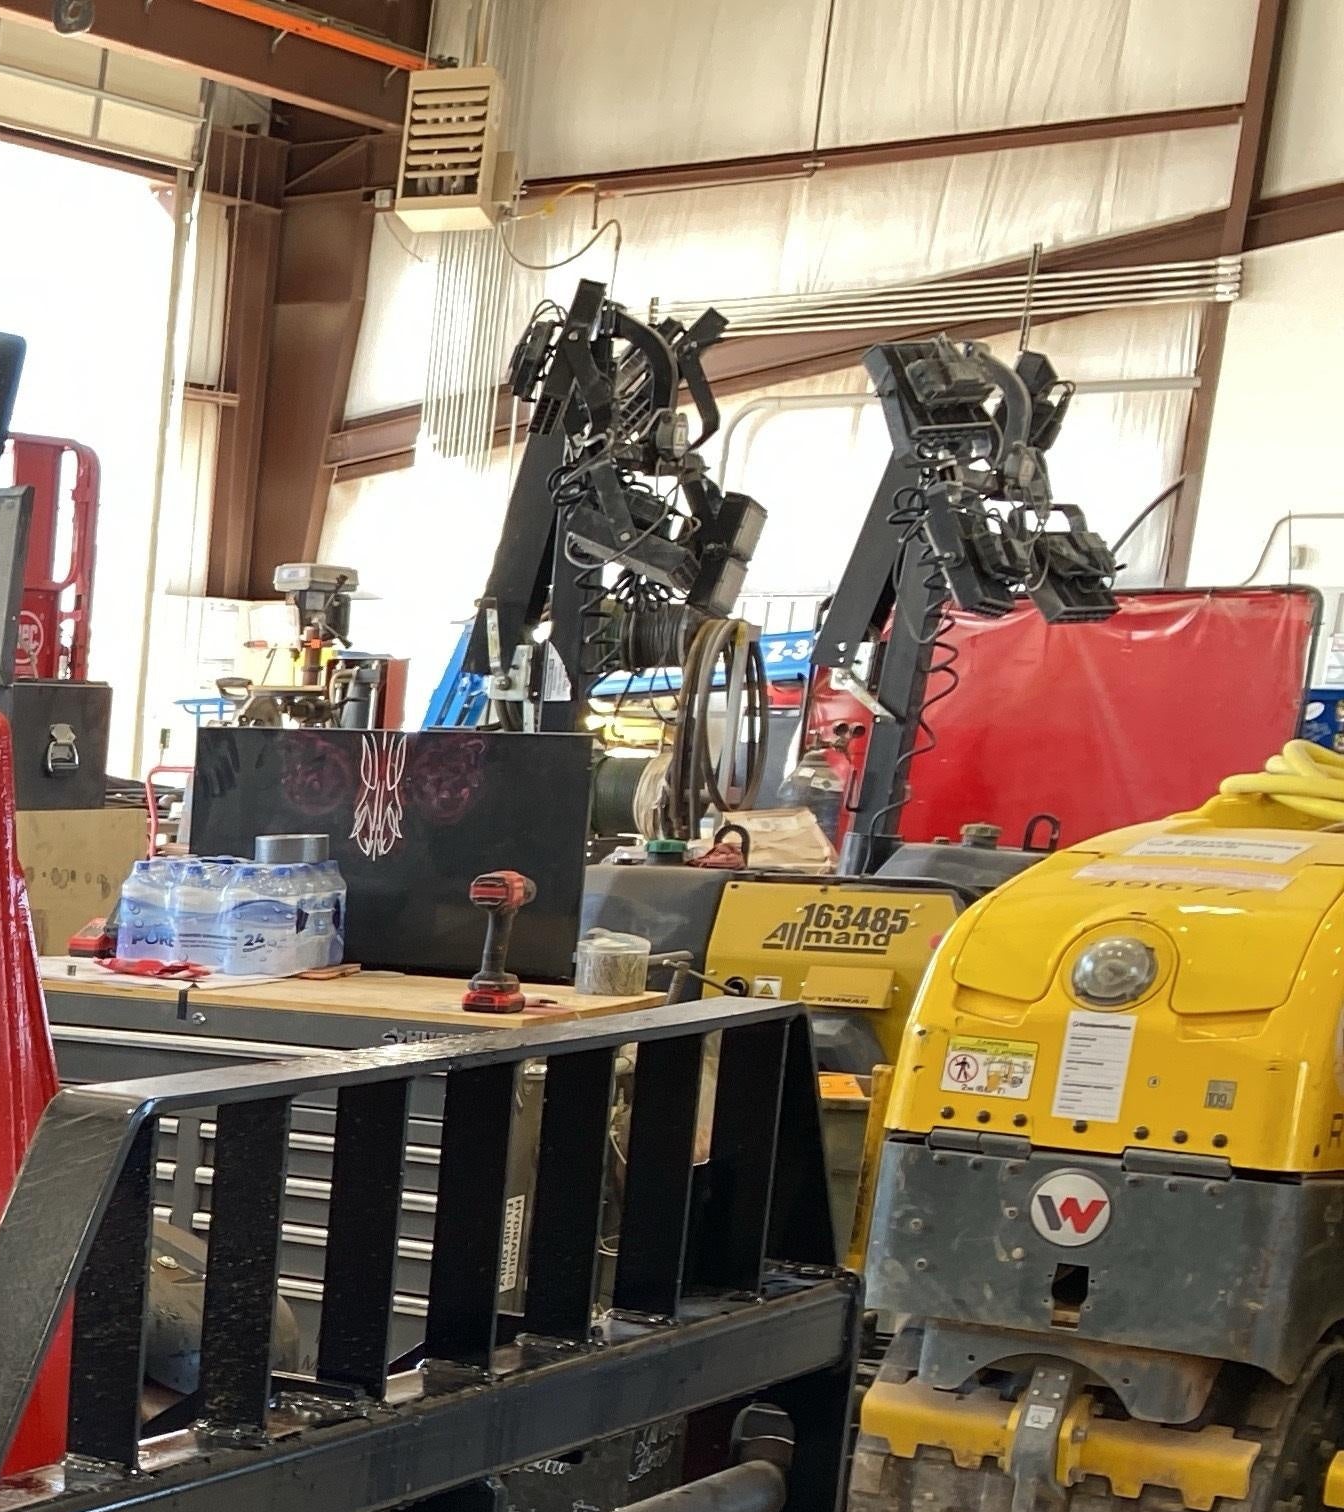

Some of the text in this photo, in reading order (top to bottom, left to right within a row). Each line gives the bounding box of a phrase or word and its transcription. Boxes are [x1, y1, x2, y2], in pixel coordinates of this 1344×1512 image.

[766, 639, 813, 664] Z-3
[802, 903, 912, 934] 163485
[763, 922, 893, 951] Allmand
[503, 1202, 514, 1246] FLUID
[506, 1199, 523, 1287] HYDRAULIC
